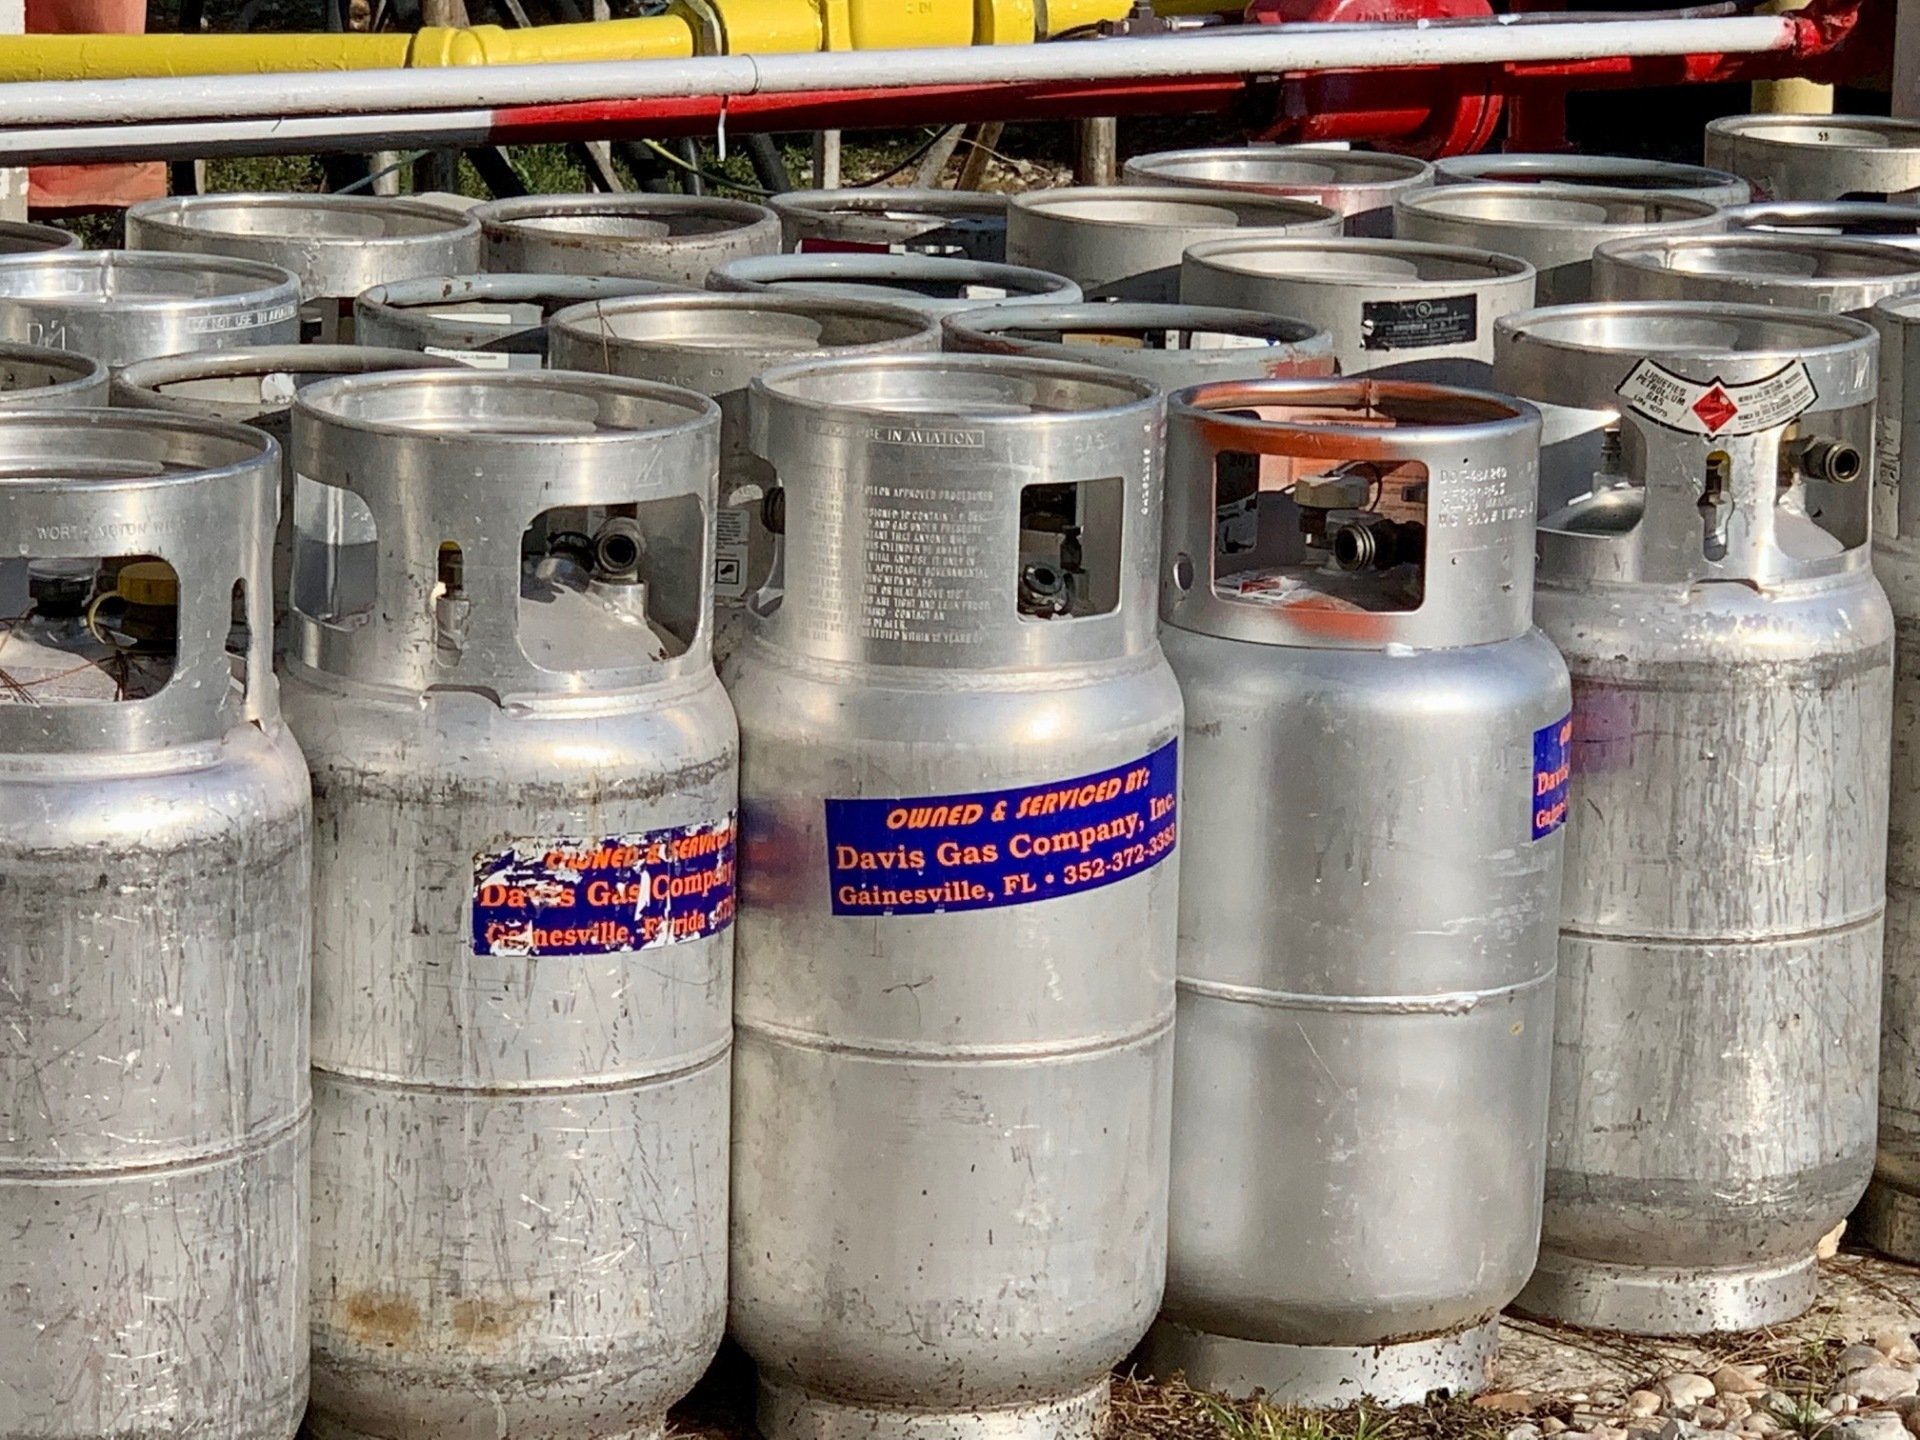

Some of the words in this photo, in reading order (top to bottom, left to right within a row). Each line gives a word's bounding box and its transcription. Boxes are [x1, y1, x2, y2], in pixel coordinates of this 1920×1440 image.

[1646, 391, 1665, 406] GAS
[887, 429, 902, 441] IN
[907, 431, 975, 445] AVIATION
[887, 803, 983, 830] OWNED
[990, 800, 1008, 823] &
[1015, 777, 1122, 818] SERVICED
[1124, 767, 1151, 794] BY:
[836, 844, 925, 870] Davis
[937, 840, 998, 867] Gas
[1008, 811, 1145, 859] Company,
[1150, 793, 1176, 822] Inc.
[480, 883, 576, 908] Das
[587, 881, 640, 907] Gas
[838, 880, 994, 906] Gainesville,
[1003, 873, 1037, 895] FL
[485, 920, 635, 948] Ganesville,
[643, 908, 706, 941] Frida
